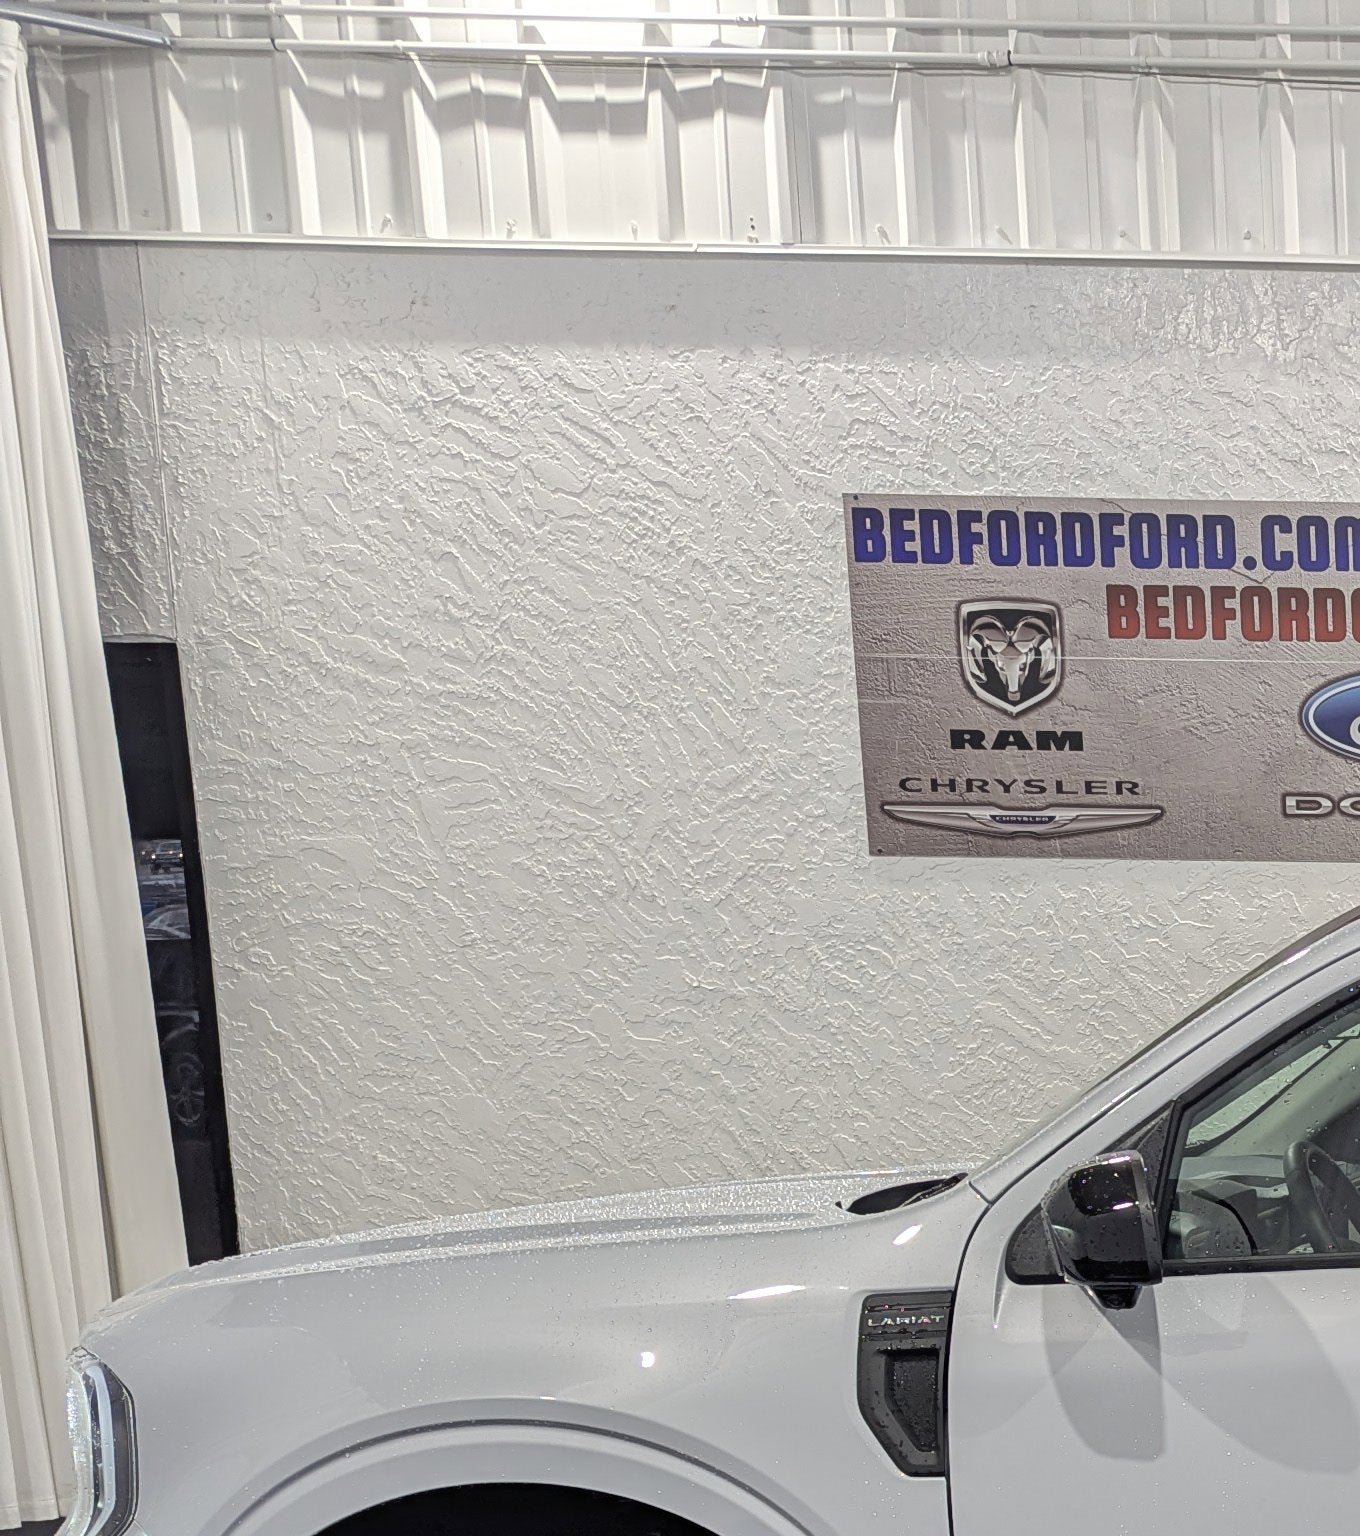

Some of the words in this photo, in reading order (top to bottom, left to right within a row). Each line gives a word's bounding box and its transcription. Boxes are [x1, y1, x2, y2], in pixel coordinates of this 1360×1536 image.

[949, 728, 1085, 752] RAM
[899, 776, 1141, 797] CHRYSLER
[867, 1314, 945, 1327] LARIAT
